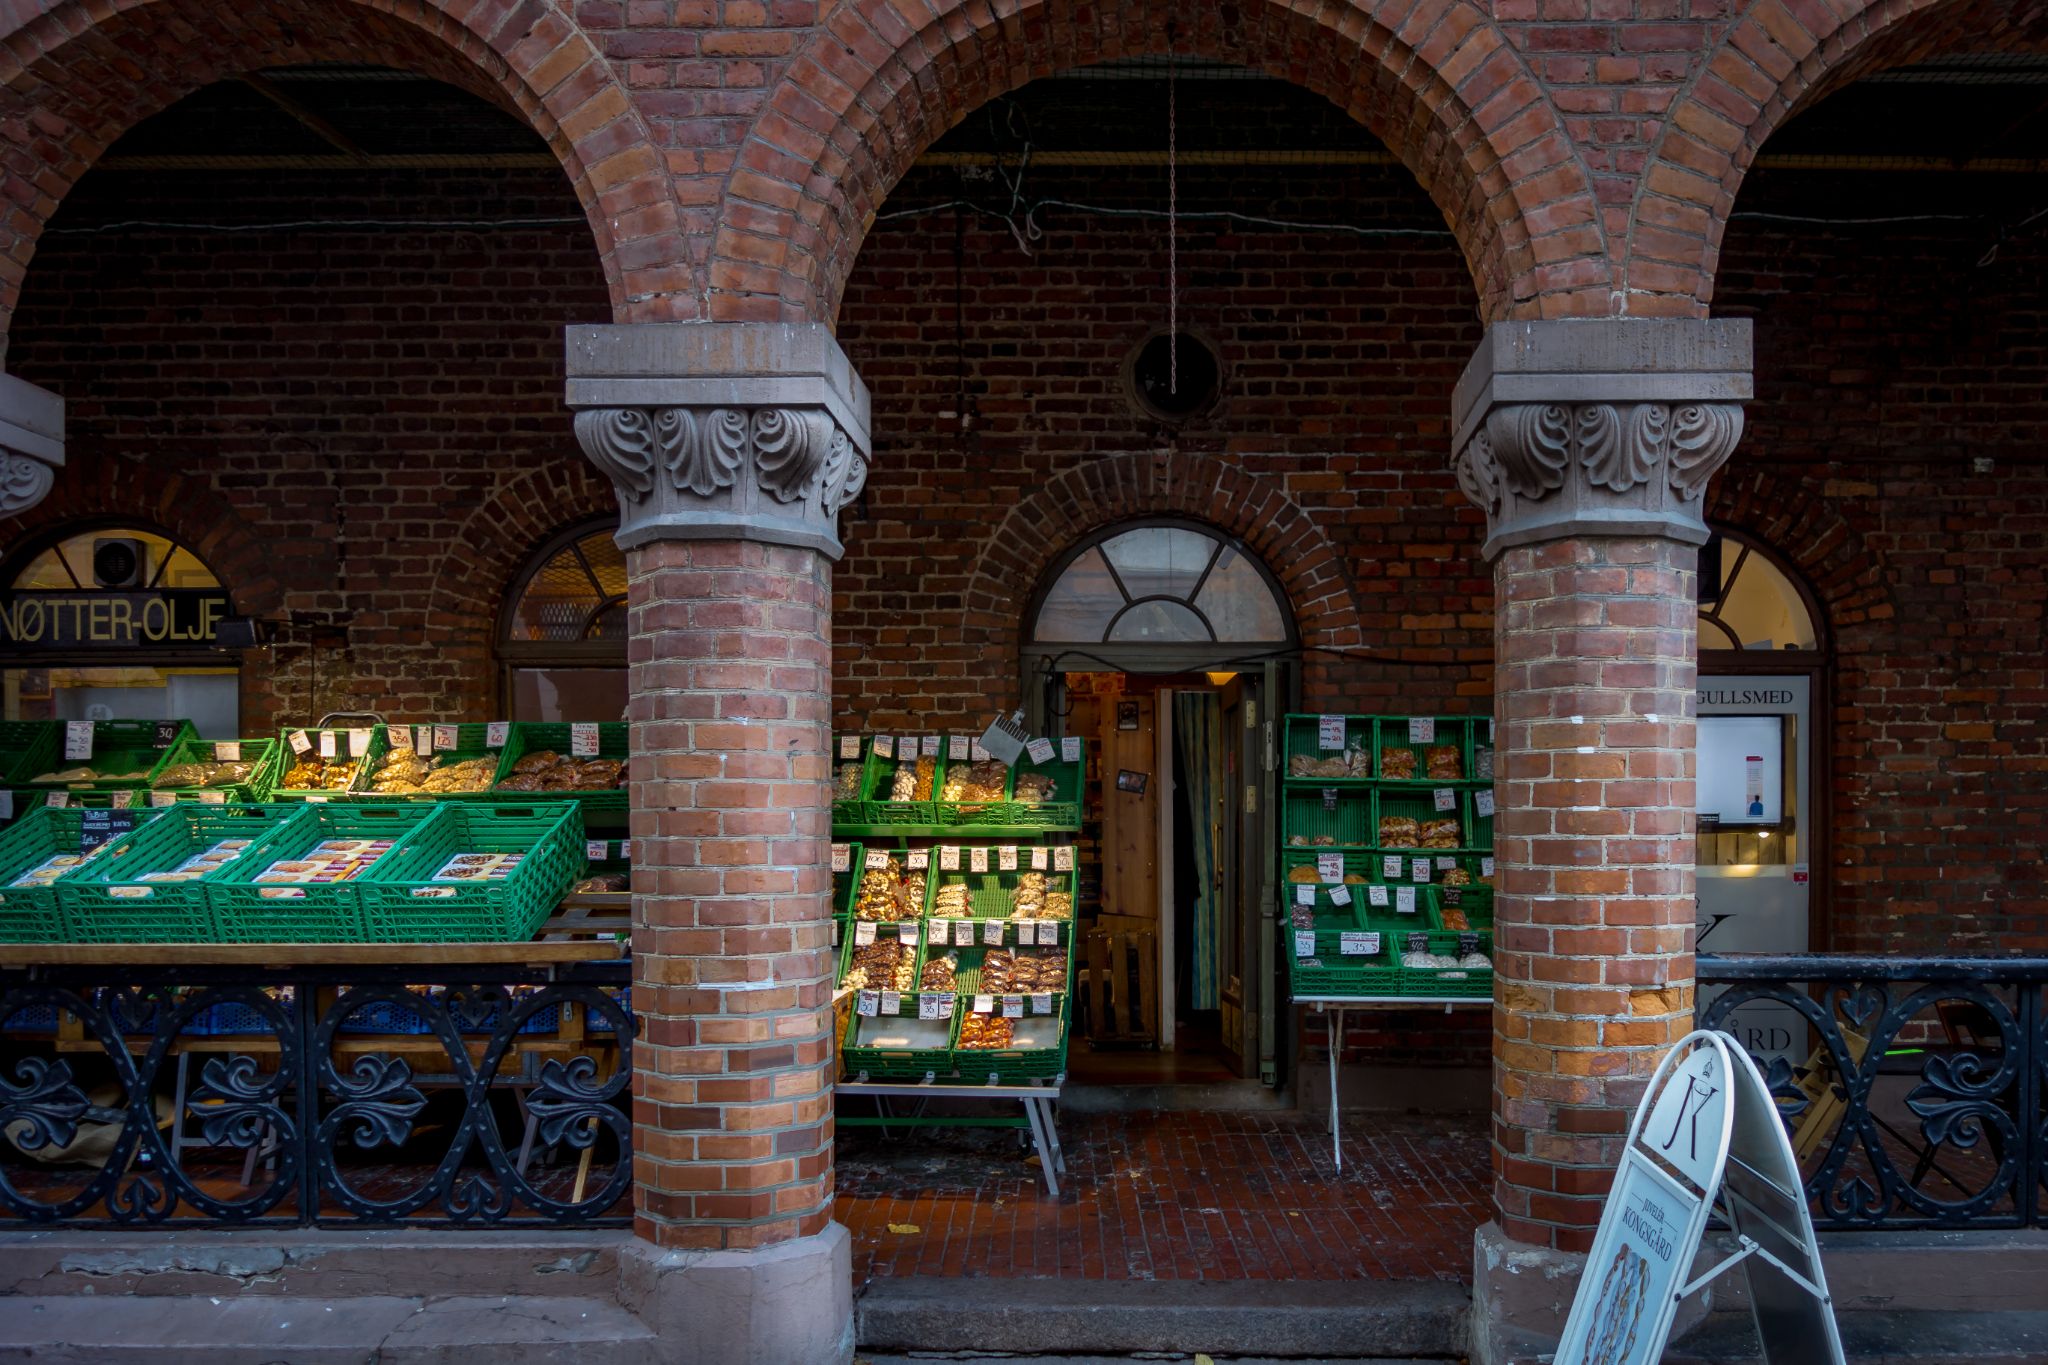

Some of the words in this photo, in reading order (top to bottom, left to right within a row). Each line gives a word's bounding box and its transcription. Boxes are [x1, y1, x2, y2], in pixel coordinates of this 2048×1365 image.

[0, 597, 225, 642] NØTTER-OLJE
[1696, 690, 1794, 705] GULLSMED
[1622, 1205, 1672, 1262] KONGSGÅRD
